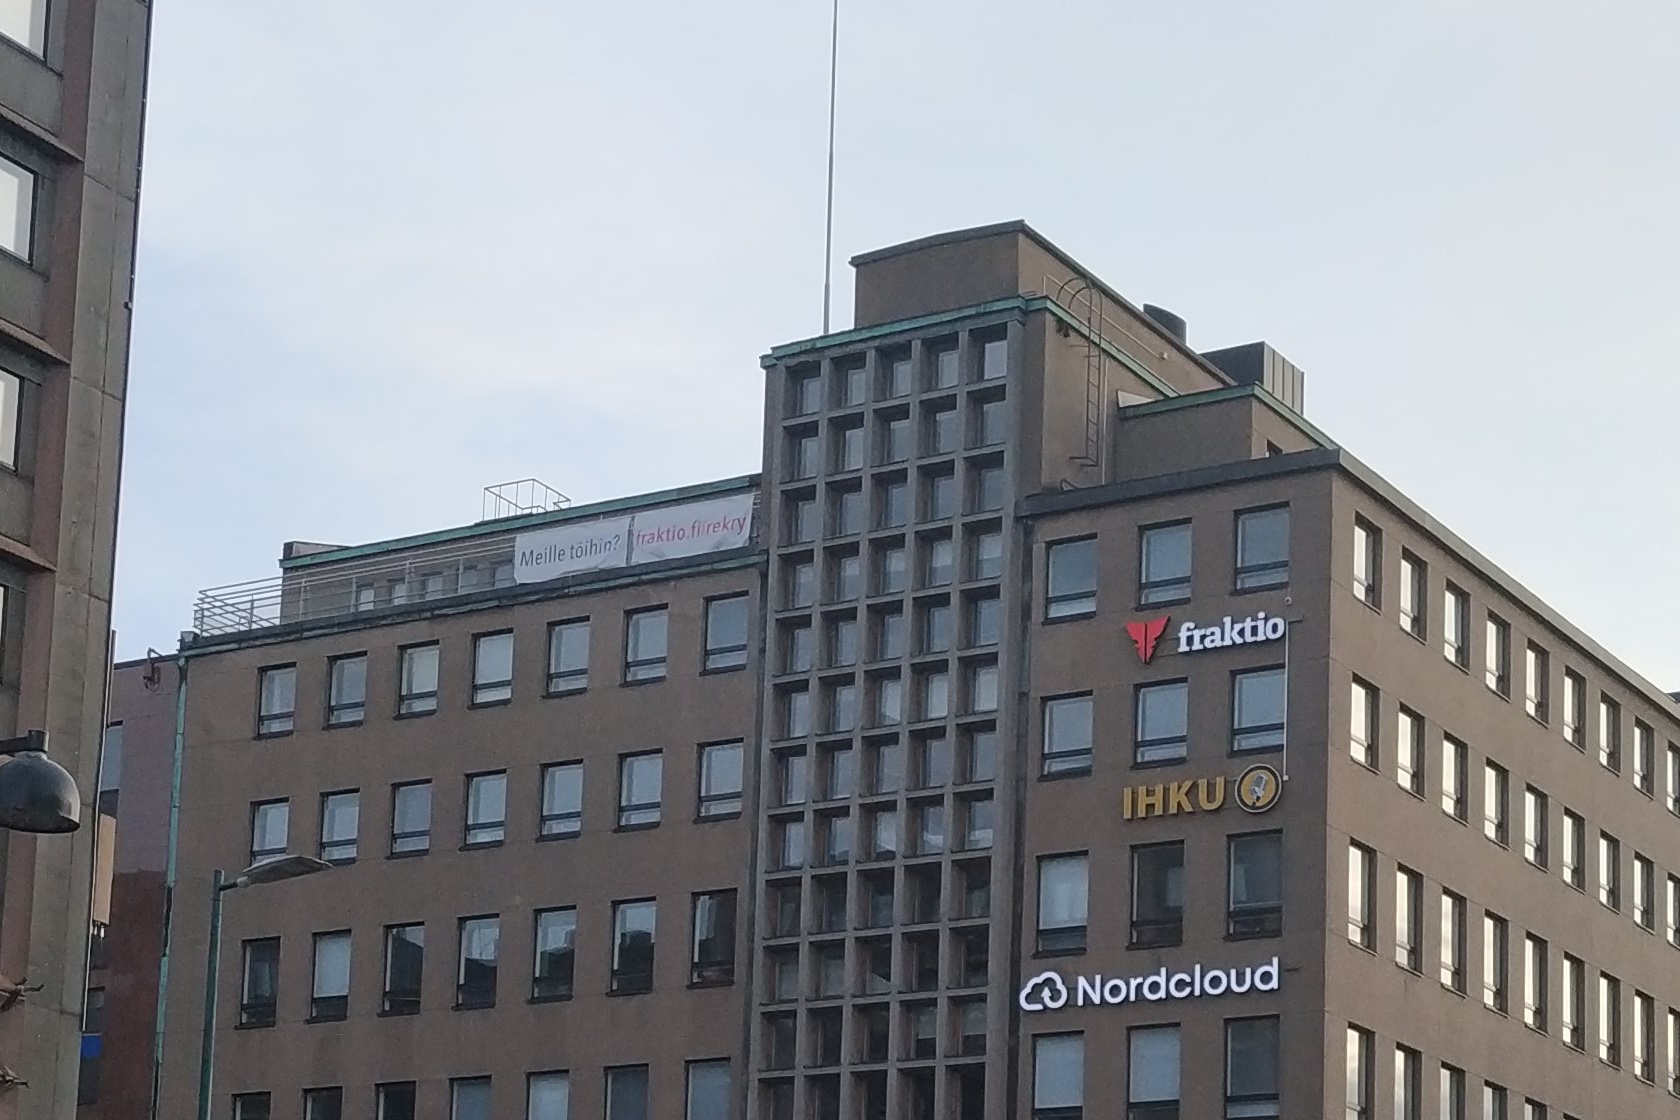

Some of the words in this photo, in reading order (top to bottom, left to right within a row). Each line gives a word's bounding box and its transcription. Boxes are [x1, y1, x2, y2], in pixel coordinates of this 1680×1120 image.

[520, 542, 565, 567] Meille
[570, 534, 621, 560] töihin?
[1177, 611, 1285, 652] fraktio
[1123, 775, 1226, 820] IHKU
[1077, 956, 1280, 1007] Nordcloud
